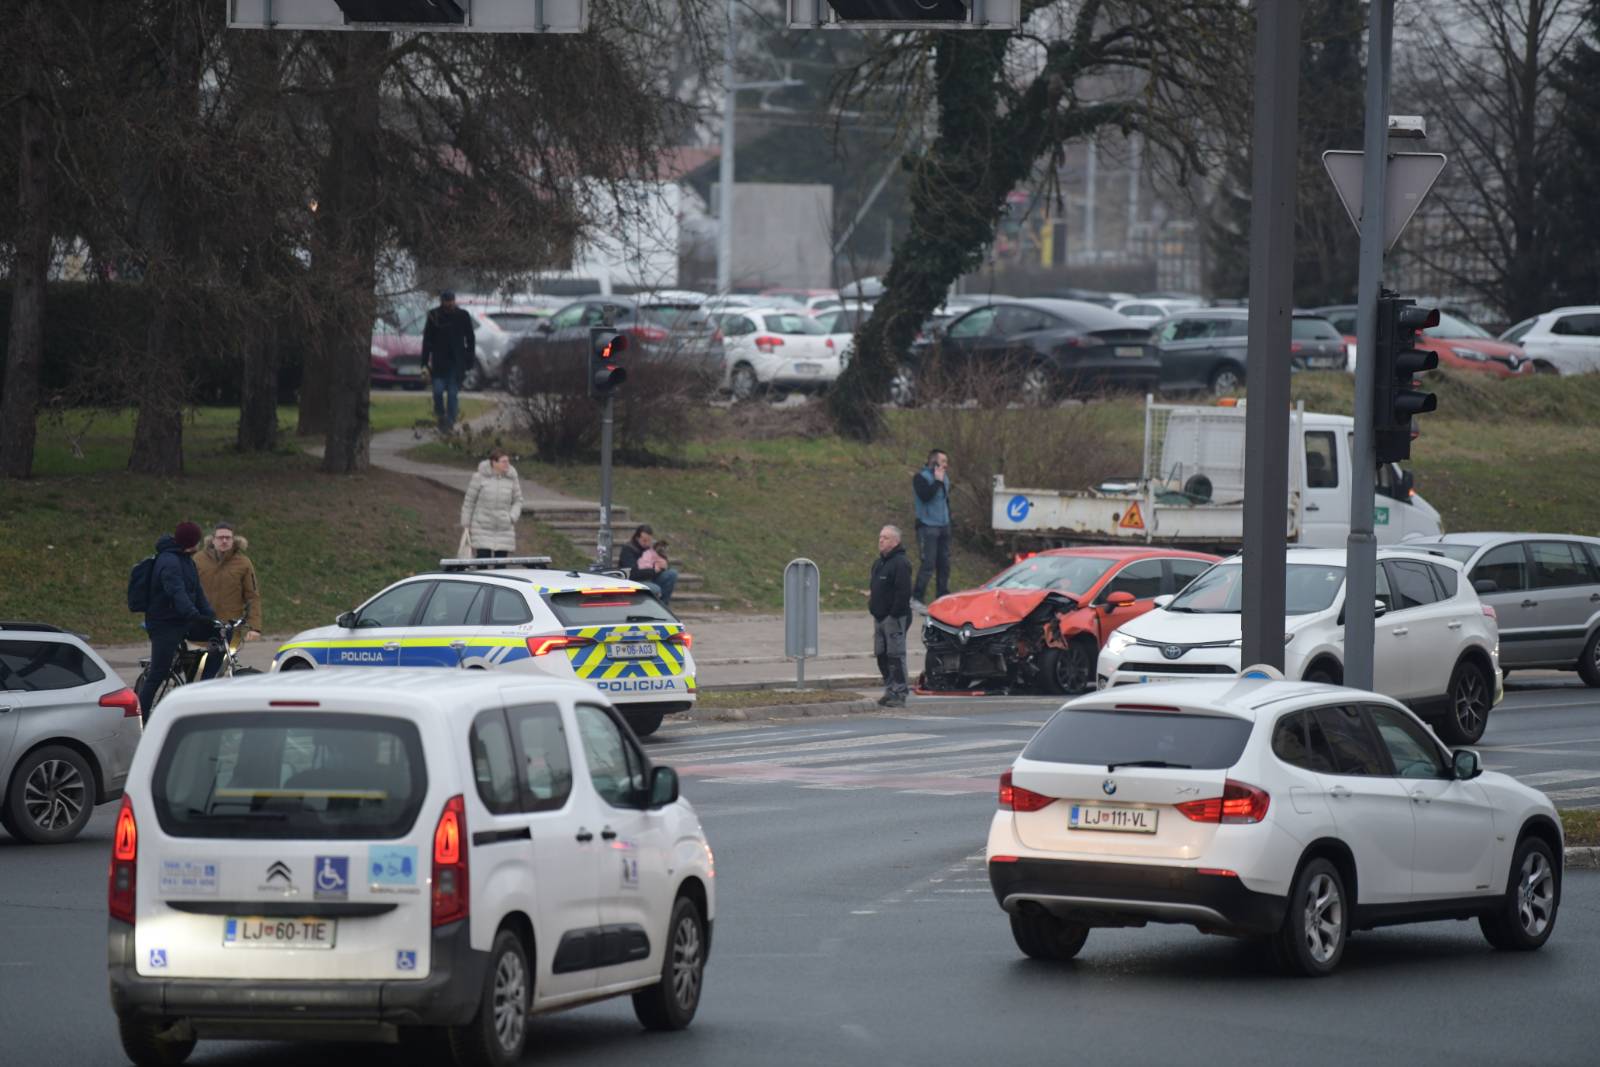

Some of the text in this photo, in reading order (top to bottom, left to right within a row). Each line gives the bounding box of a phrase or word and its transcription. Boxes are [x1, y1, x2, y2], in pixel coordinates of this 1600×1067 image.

[341, 651, 383, 661] POLICIJA
[597, 680, 675, 691] POLICIJA
[1085, 809, 1147, 827] LJ 111-VL
[242, 922, 327, 941] LJ 60-TIE
